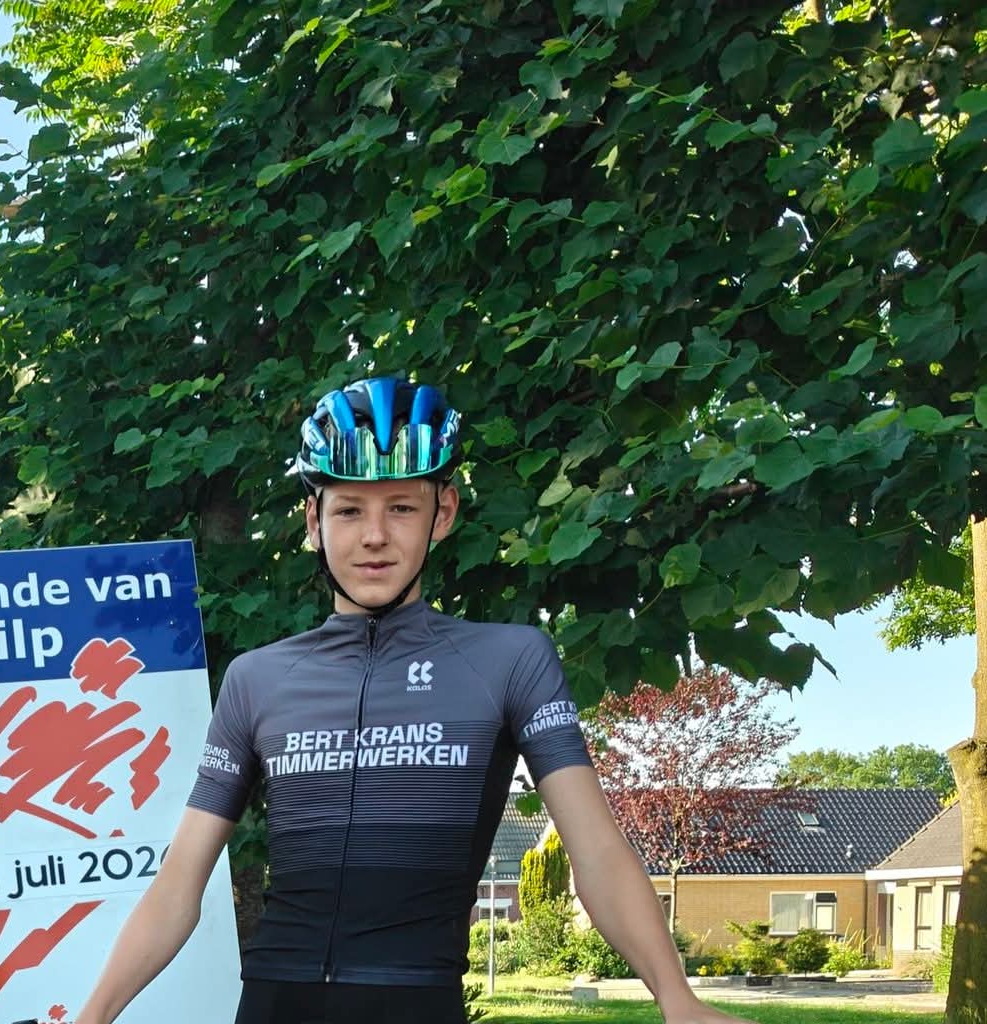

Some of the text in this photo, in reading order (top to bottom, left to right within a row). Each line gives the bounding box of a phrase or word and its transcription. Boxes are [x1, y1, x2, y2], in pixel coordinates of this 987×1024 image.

[85, 572, 172, 602] van
[284, 722, 444, 752] BERT KRANS
[265, 744, 469, 777] TIMMERWERKEN
[7, 854, 66, 900] juli
[77, 845, 170, 884] 202
